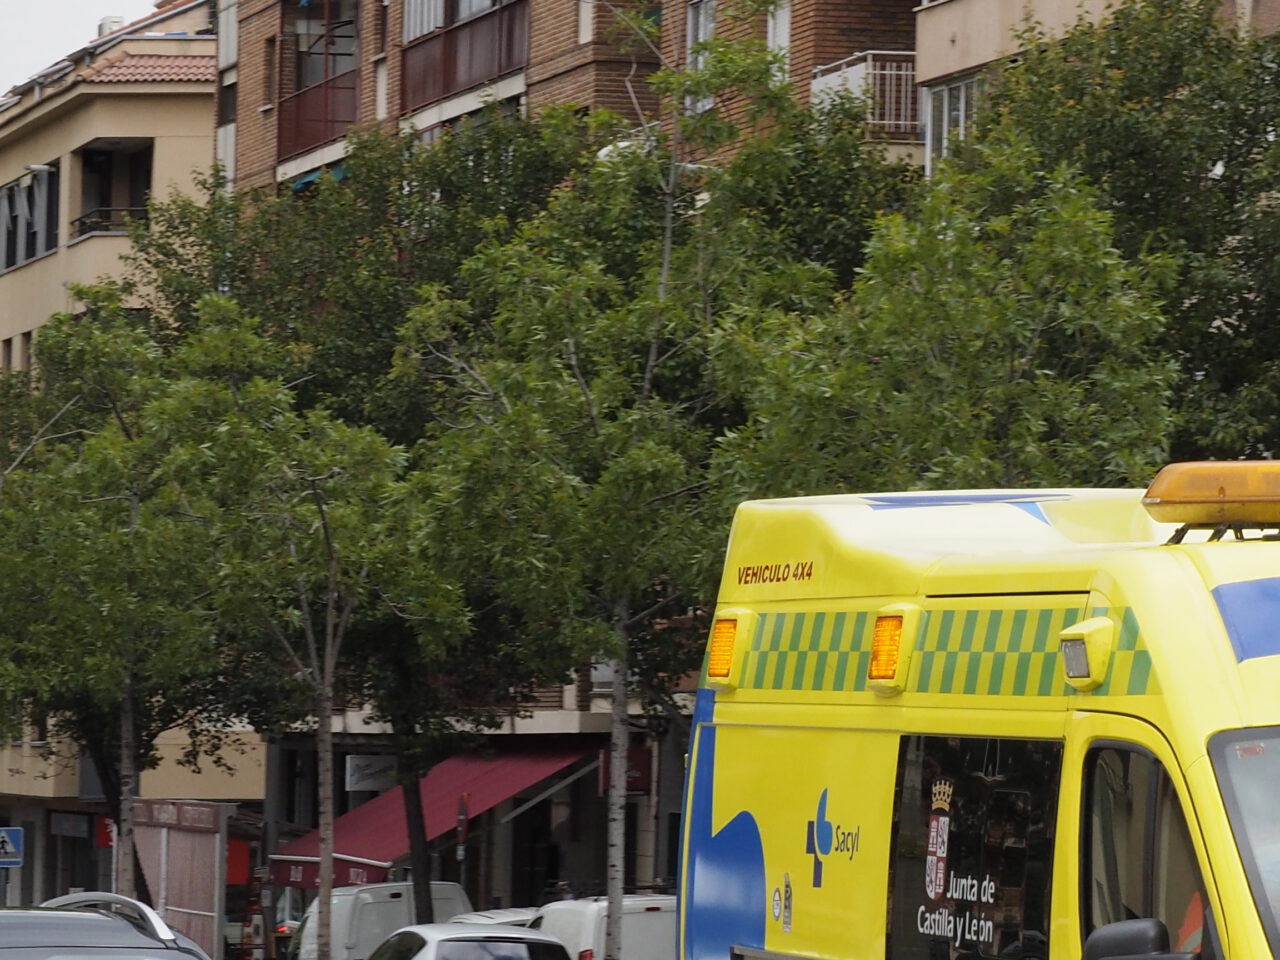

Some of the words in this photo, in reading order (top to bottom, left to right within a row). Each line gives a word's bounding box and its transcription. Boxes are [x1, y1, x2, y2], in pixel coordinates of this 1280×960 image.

[738, 563, 791, 585] VEHICULO
[792, 561, 814, 581] 4X4
[834, 824, 860, 861] Sacyl
[946, 870, 978, 901] Junta
[980, 873, 995, 903] de
[917, 905, 954, 937] Castilla
[955, 917, 964, 947] y
[965, 911, 993, 943] León
